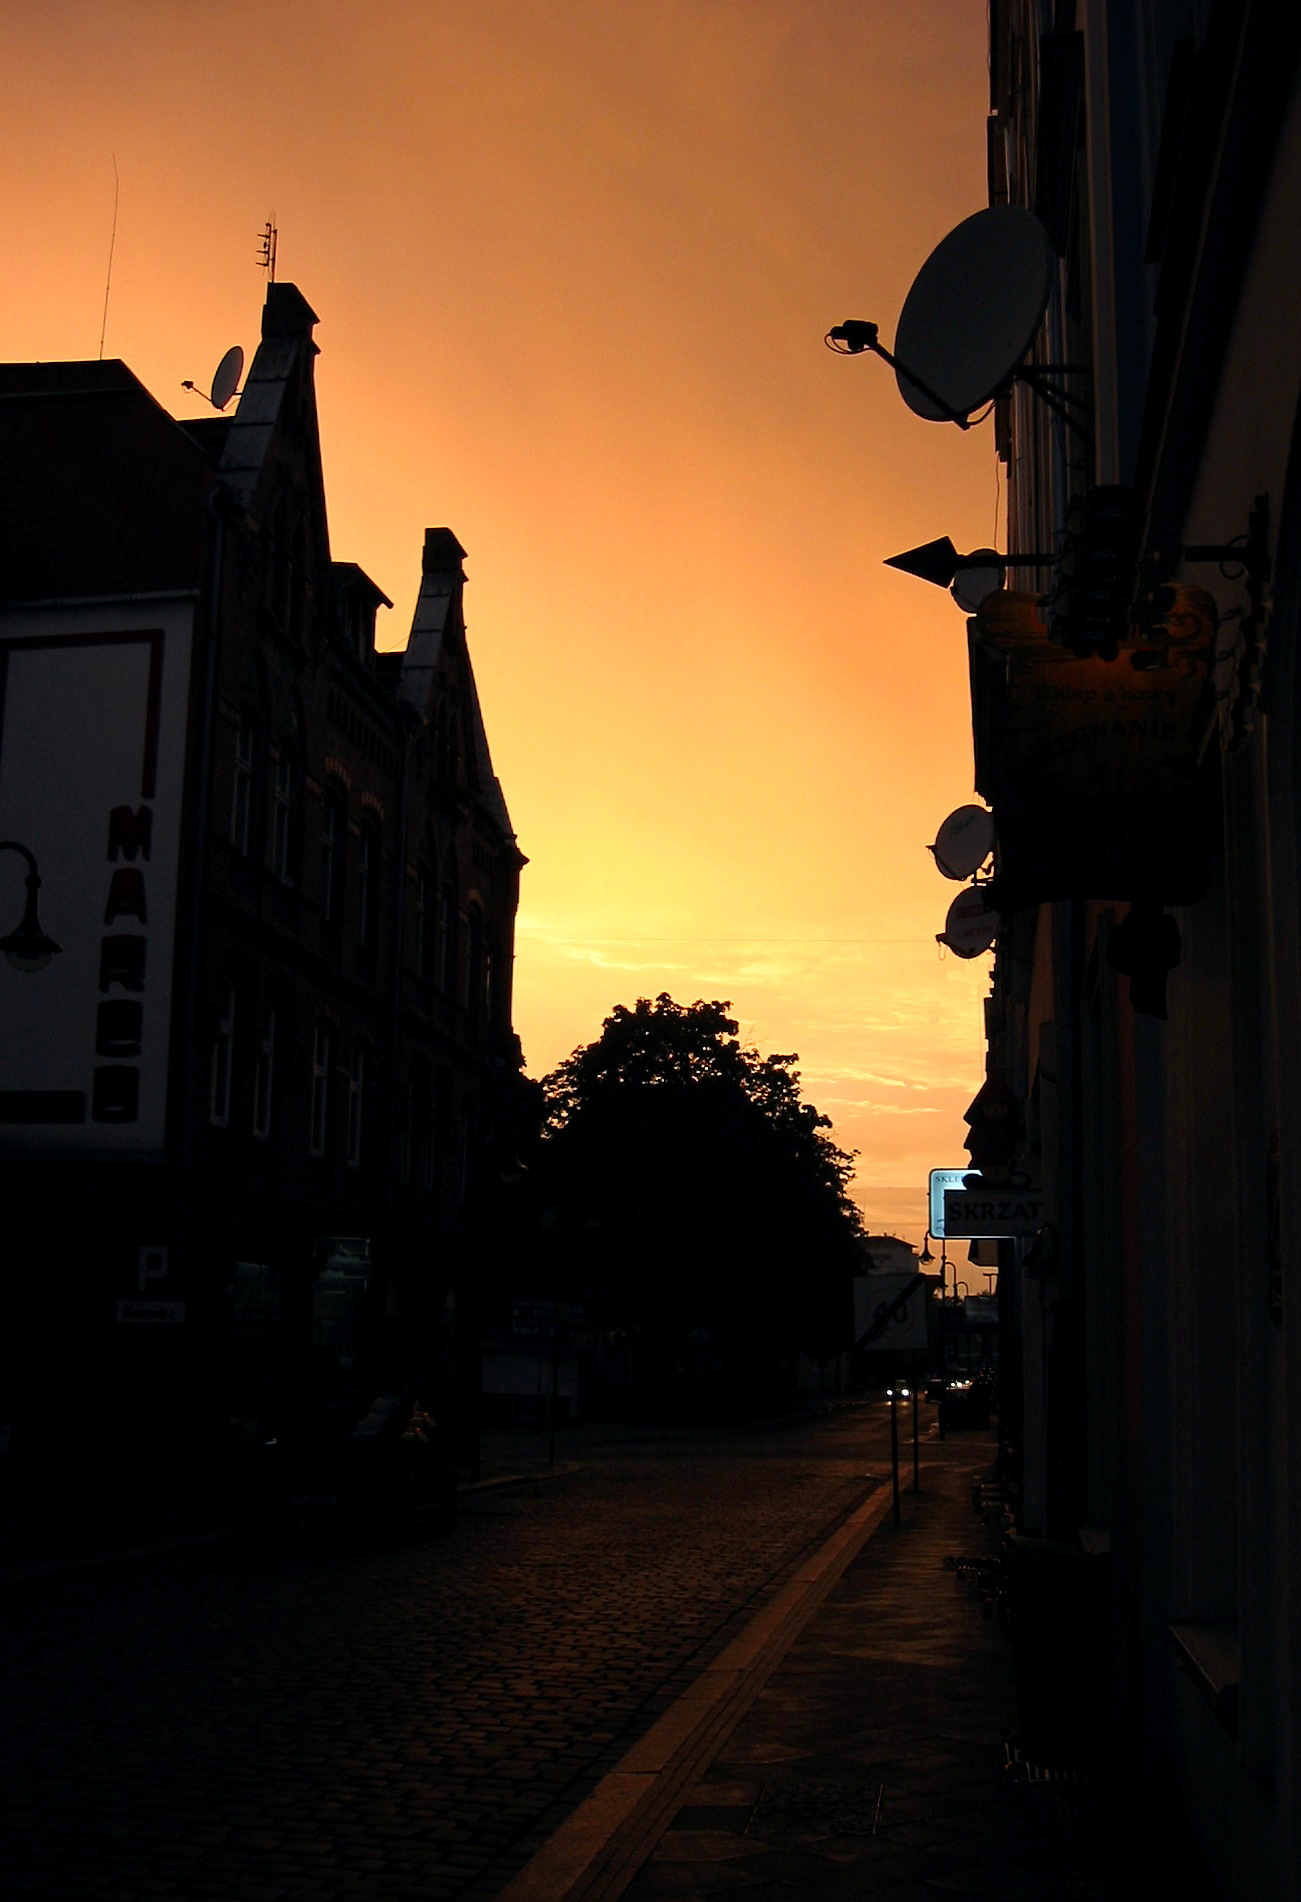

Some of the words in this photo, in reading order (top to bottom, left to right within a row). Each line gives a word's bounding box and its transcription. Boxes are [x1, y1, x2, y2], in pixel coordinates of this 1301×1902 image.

[935, 1175, 965, 1183] SKLE
[948, 1202, 1042, 1221] SKRZAT
[137, 1244, 169, 1290] P
